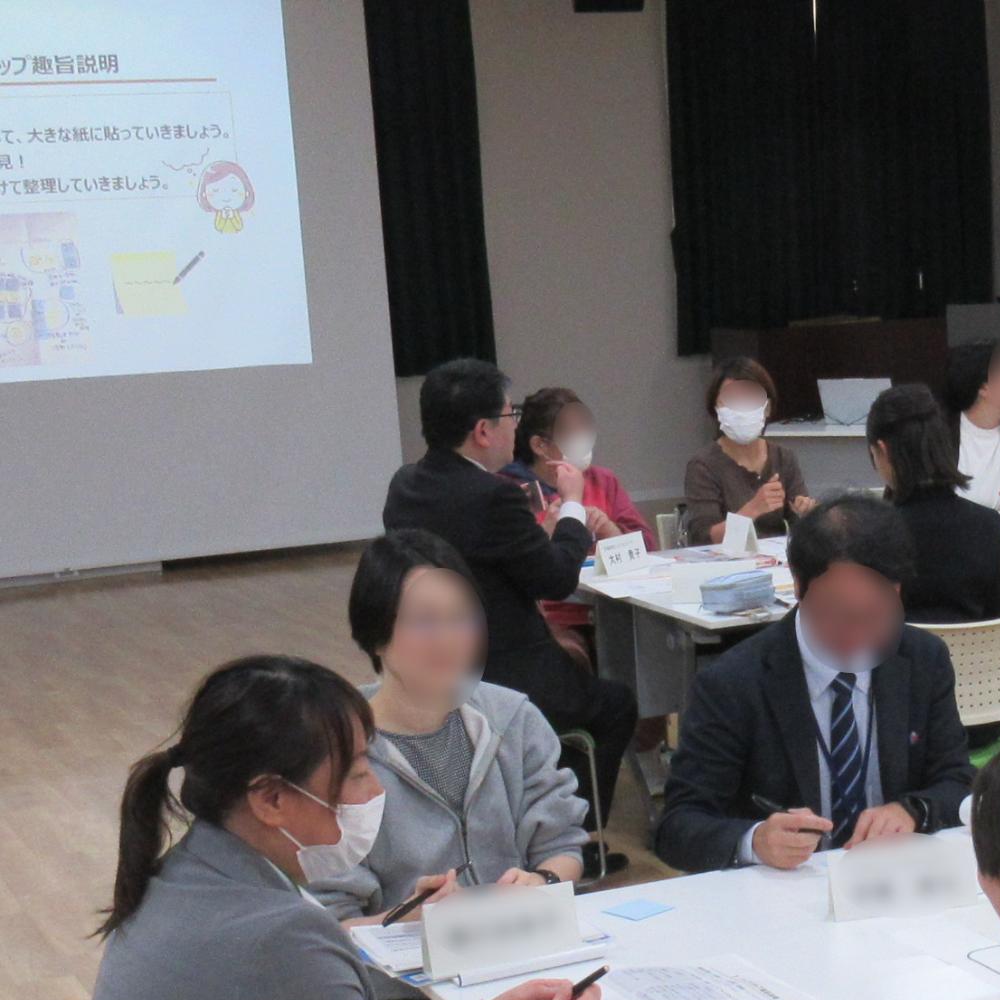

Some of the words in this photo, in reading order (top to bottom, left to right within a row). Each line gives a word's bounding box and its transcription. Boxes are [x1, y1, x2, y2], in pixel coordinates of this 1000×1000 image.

[0, 124, 229, 145] て、大きな紙に貼っていきましょう。
